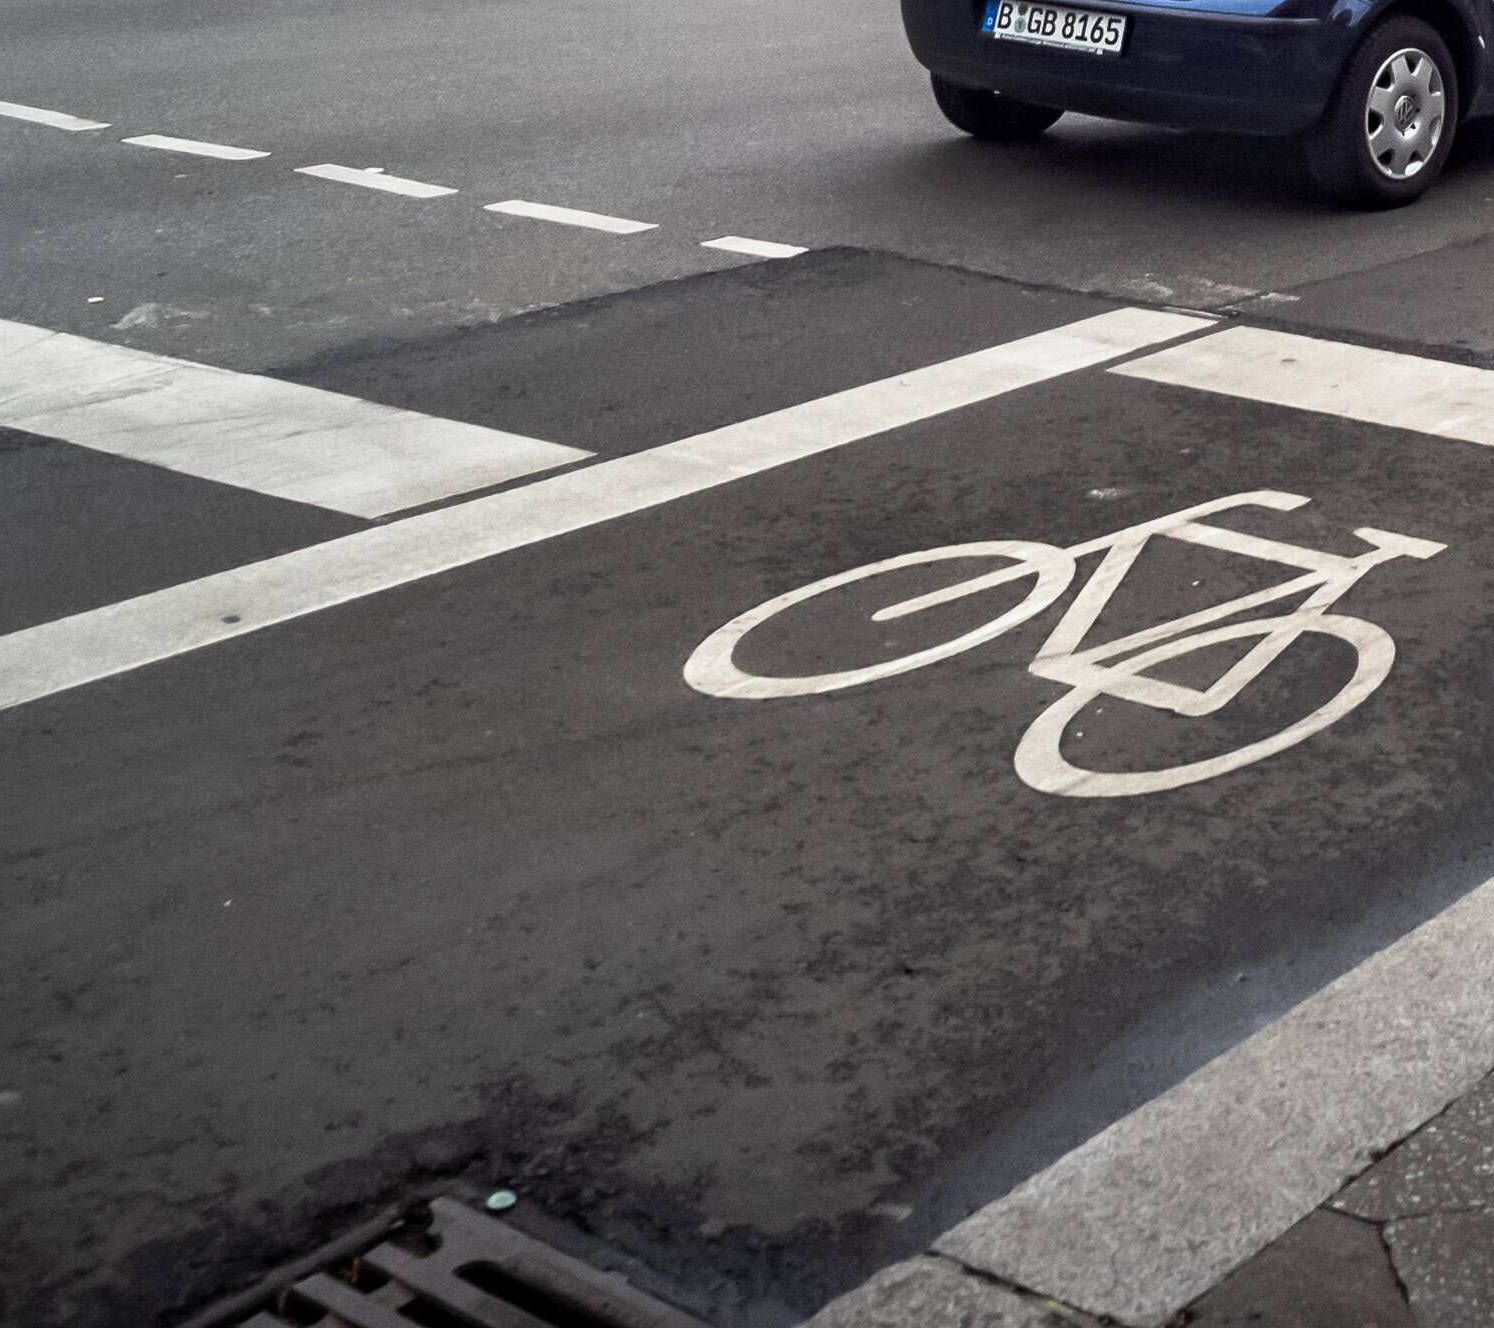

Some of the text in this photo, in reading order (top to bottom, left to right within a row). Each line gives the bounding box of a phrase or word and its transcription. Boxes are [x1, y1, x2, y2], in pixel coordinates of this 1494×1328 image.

[997, 2, 1014, 30] B
[1027, 6, 1058, 36] GB
[1061, 12, 1123, 46] 8165
